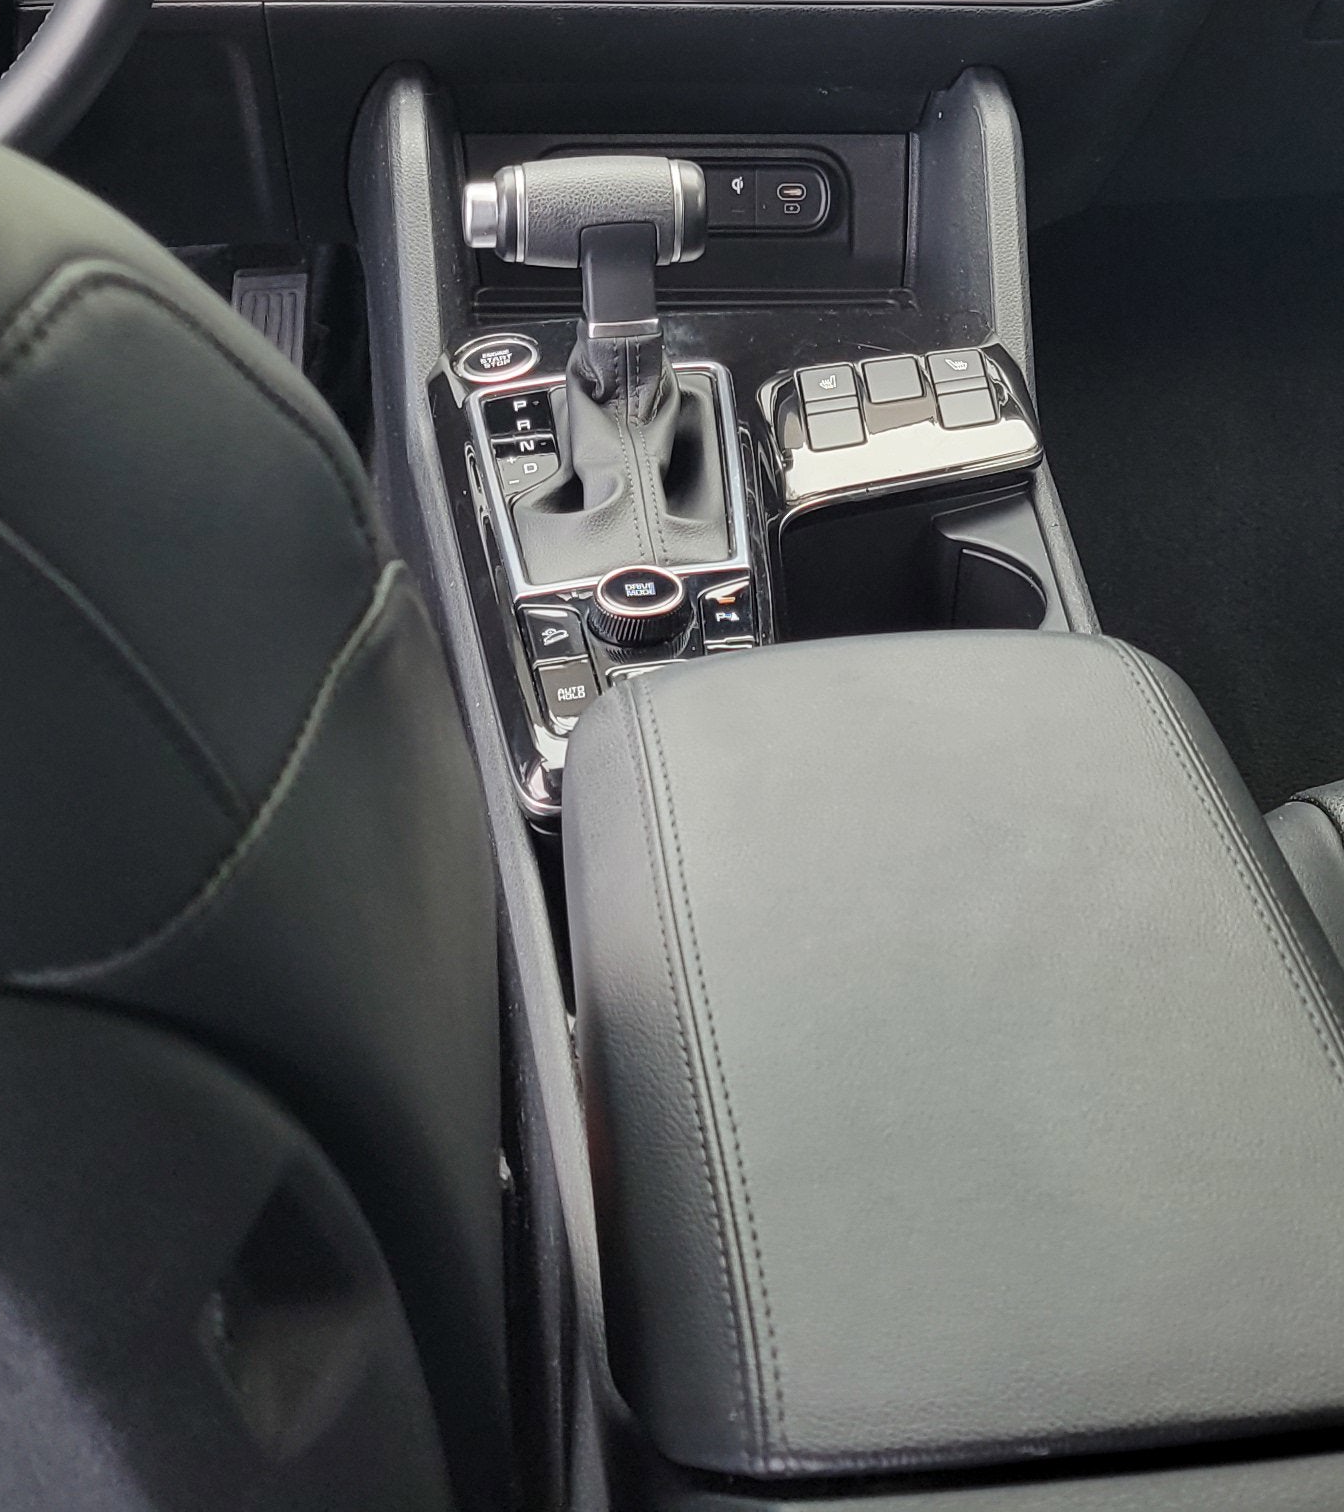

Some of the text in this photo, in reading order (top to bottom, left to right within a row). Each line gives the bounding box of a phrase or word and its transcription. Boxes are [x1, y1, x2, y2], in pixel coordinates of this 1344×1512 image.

[479, 352, 513, 365] START
[513, 400, 527, 412] P
[519, 439, 535, 453] N
[523, 462, 538, 475] D
[557, 685, 585, 694] AUTO
[557, 691, 586, 702] HOLD
